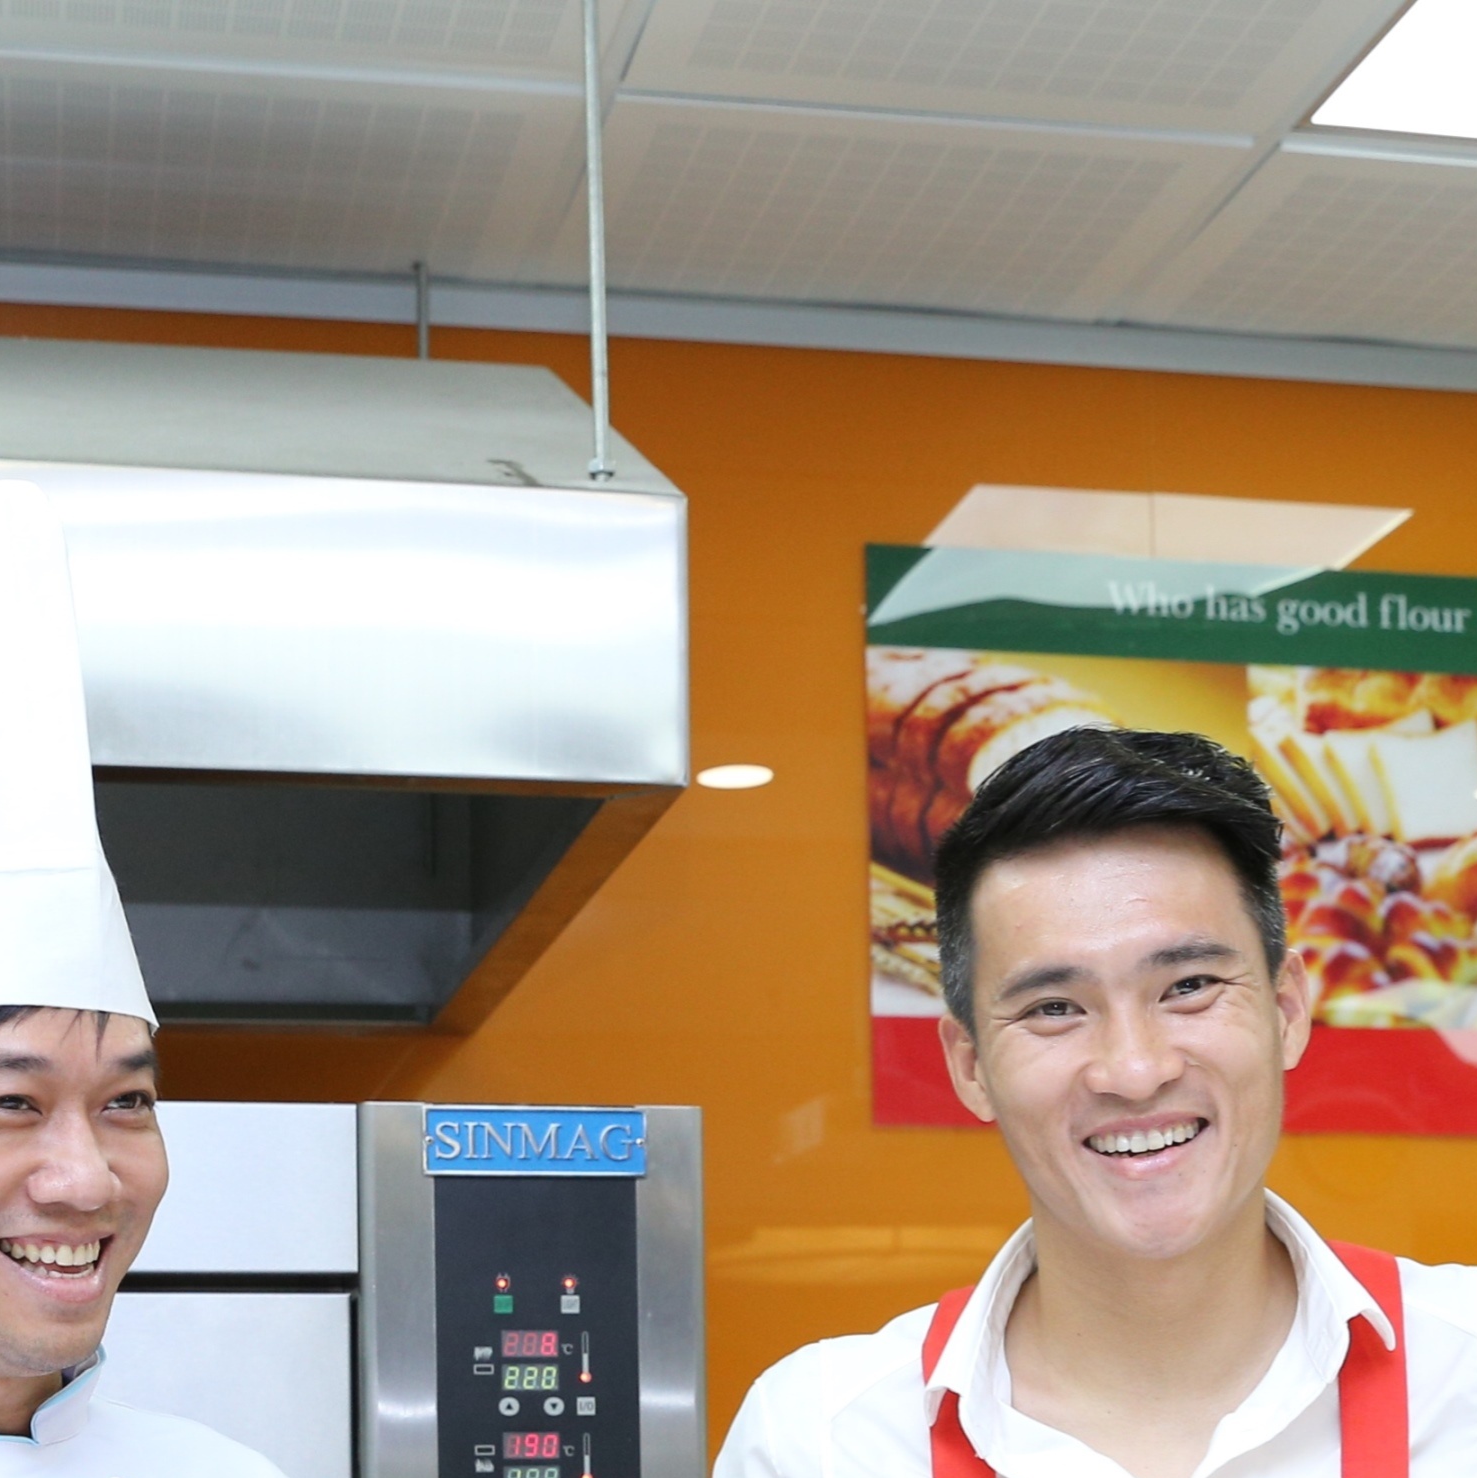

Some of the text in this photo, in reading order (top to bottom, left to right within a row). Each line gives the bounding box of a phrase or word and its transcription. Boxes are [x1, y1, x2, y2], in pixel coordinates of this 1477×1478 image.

[1108, 580, 1194, 619] Who
[1206, 584, 1266, 622] has
[1276, 592, 1369, 636] good
[1378, 592, 1471, 634] flour
[434, 1121, 635, 1163] SINMAG
